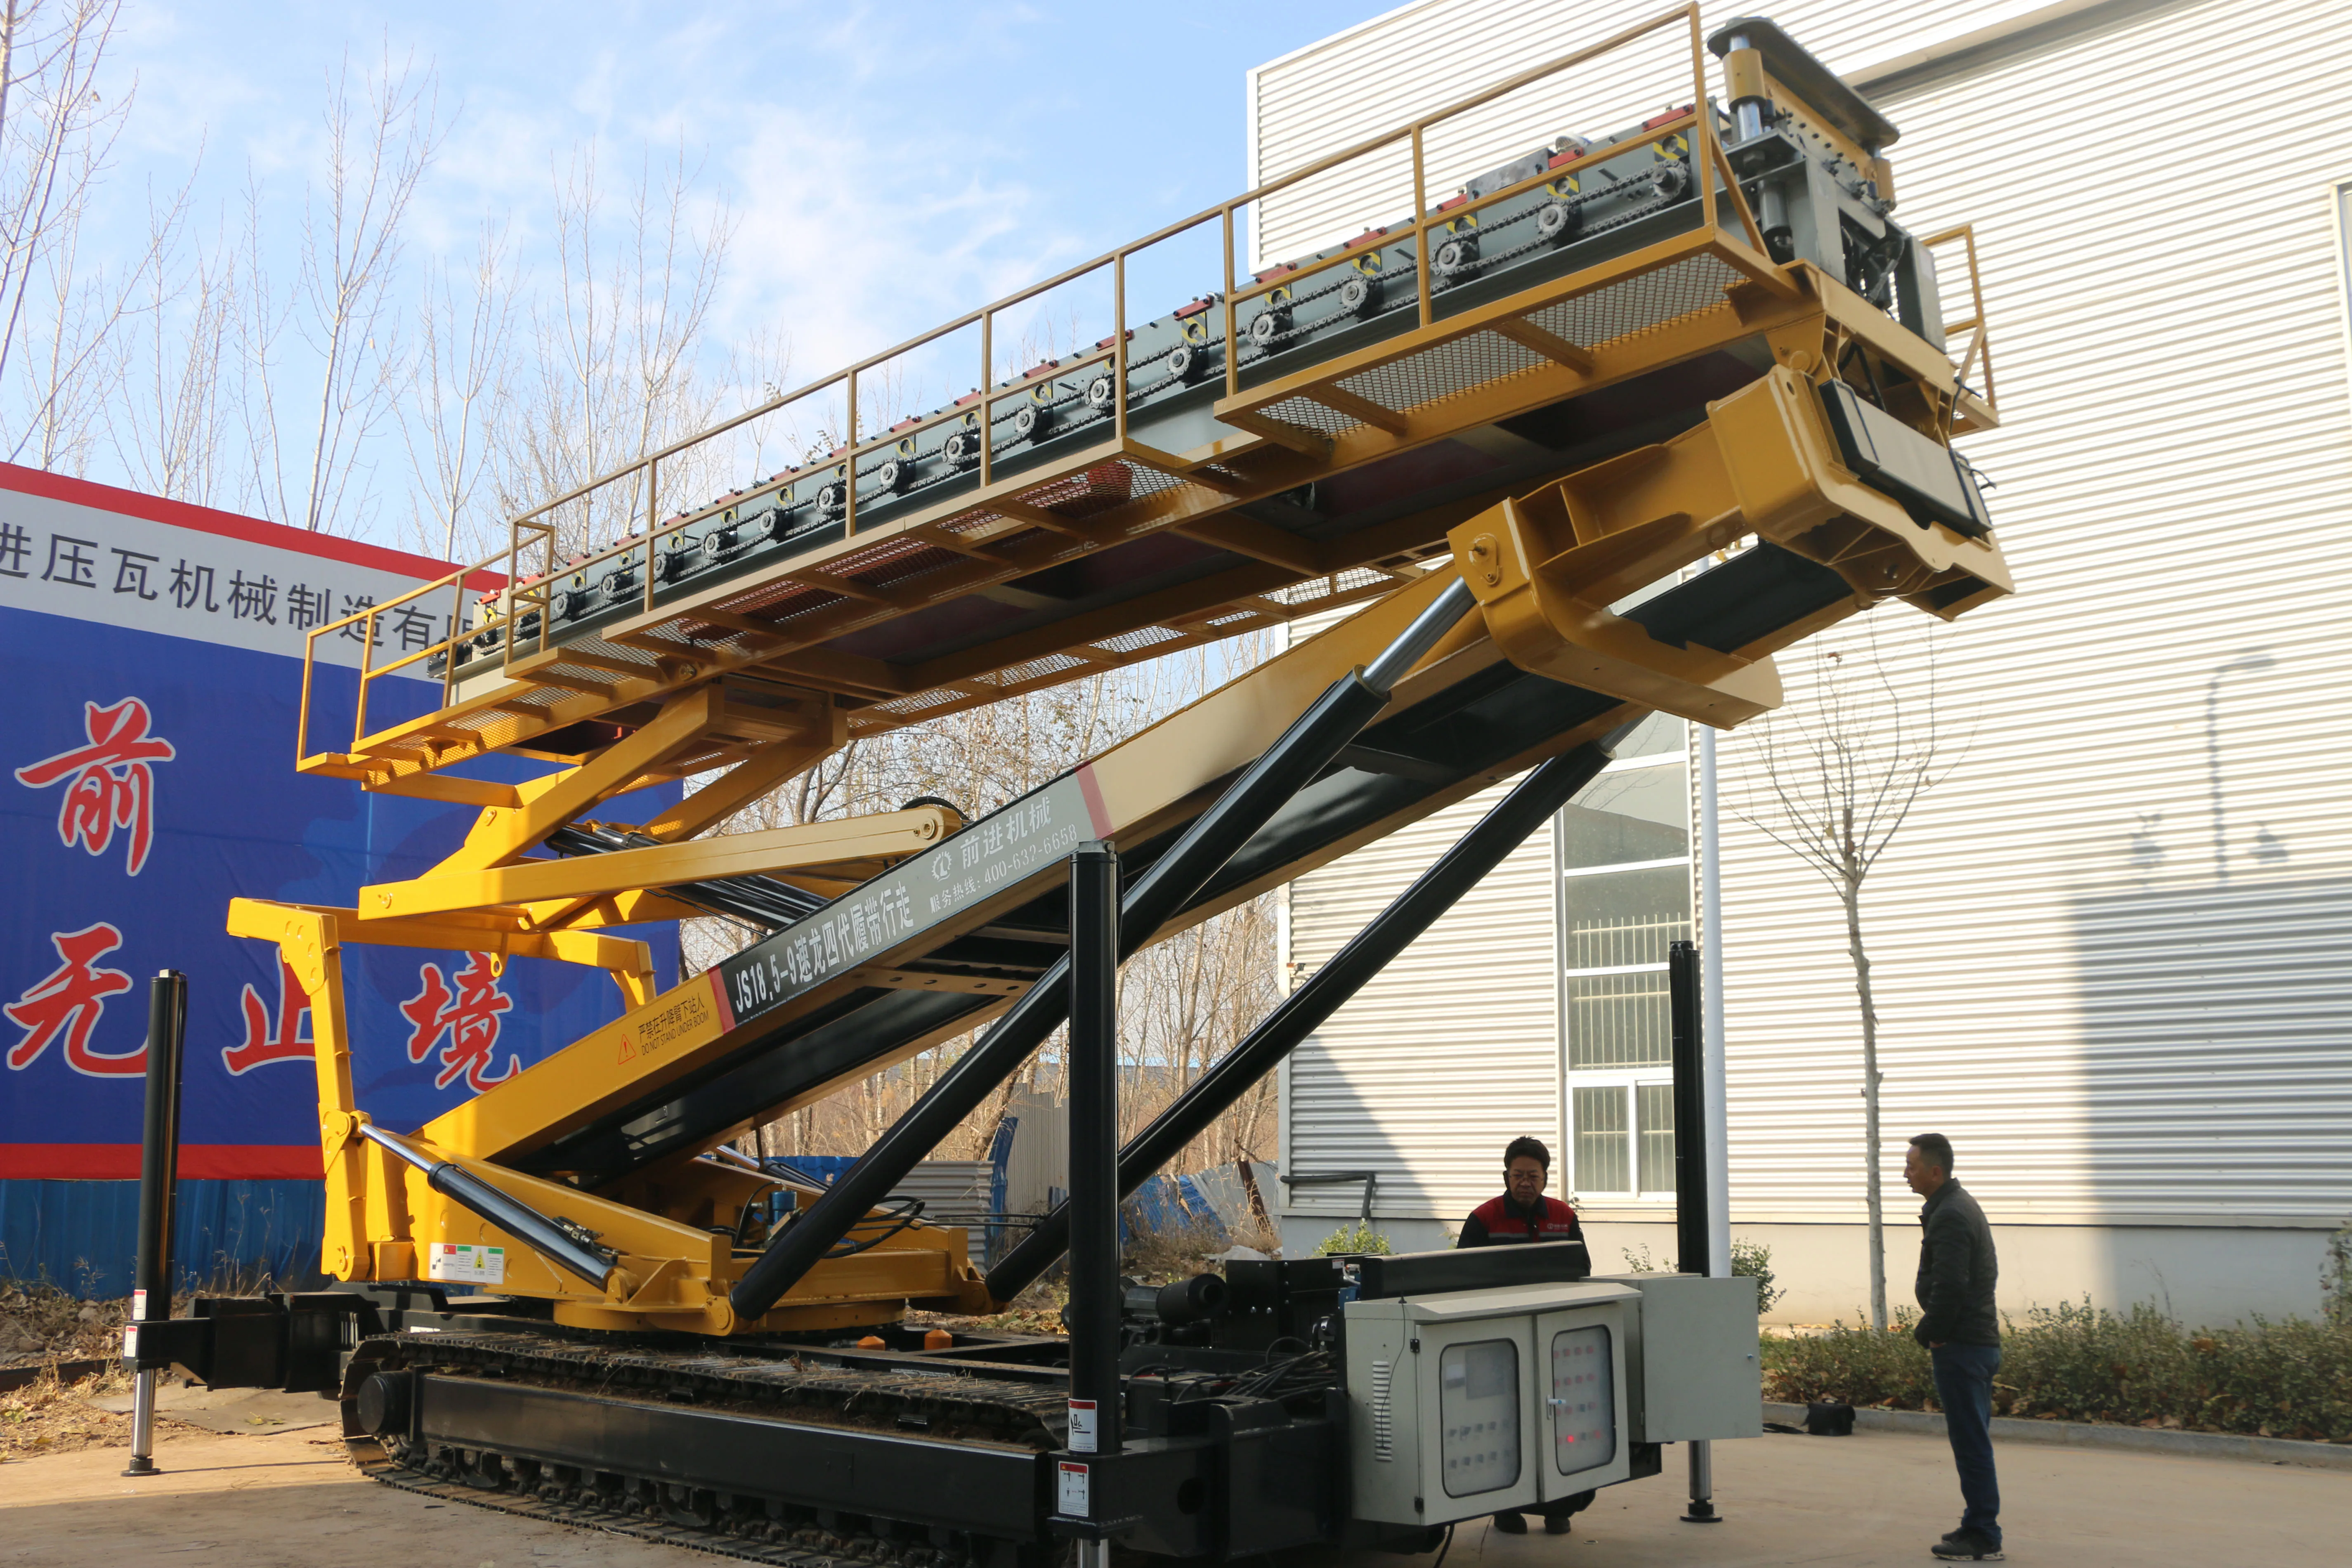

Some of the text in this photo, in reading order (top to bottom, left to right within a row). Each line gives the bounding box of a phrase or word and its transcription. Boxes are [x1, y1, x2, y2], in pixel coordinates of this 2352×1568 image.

[15, 696, 175, 876] 前
[960, 796, 1051, 869] 前进机械
[638, 992, 704, 1044] 严禁在升降臂下站人
[642, 1011, 709, 1056] DO NOT STAND UNDER BOOM
